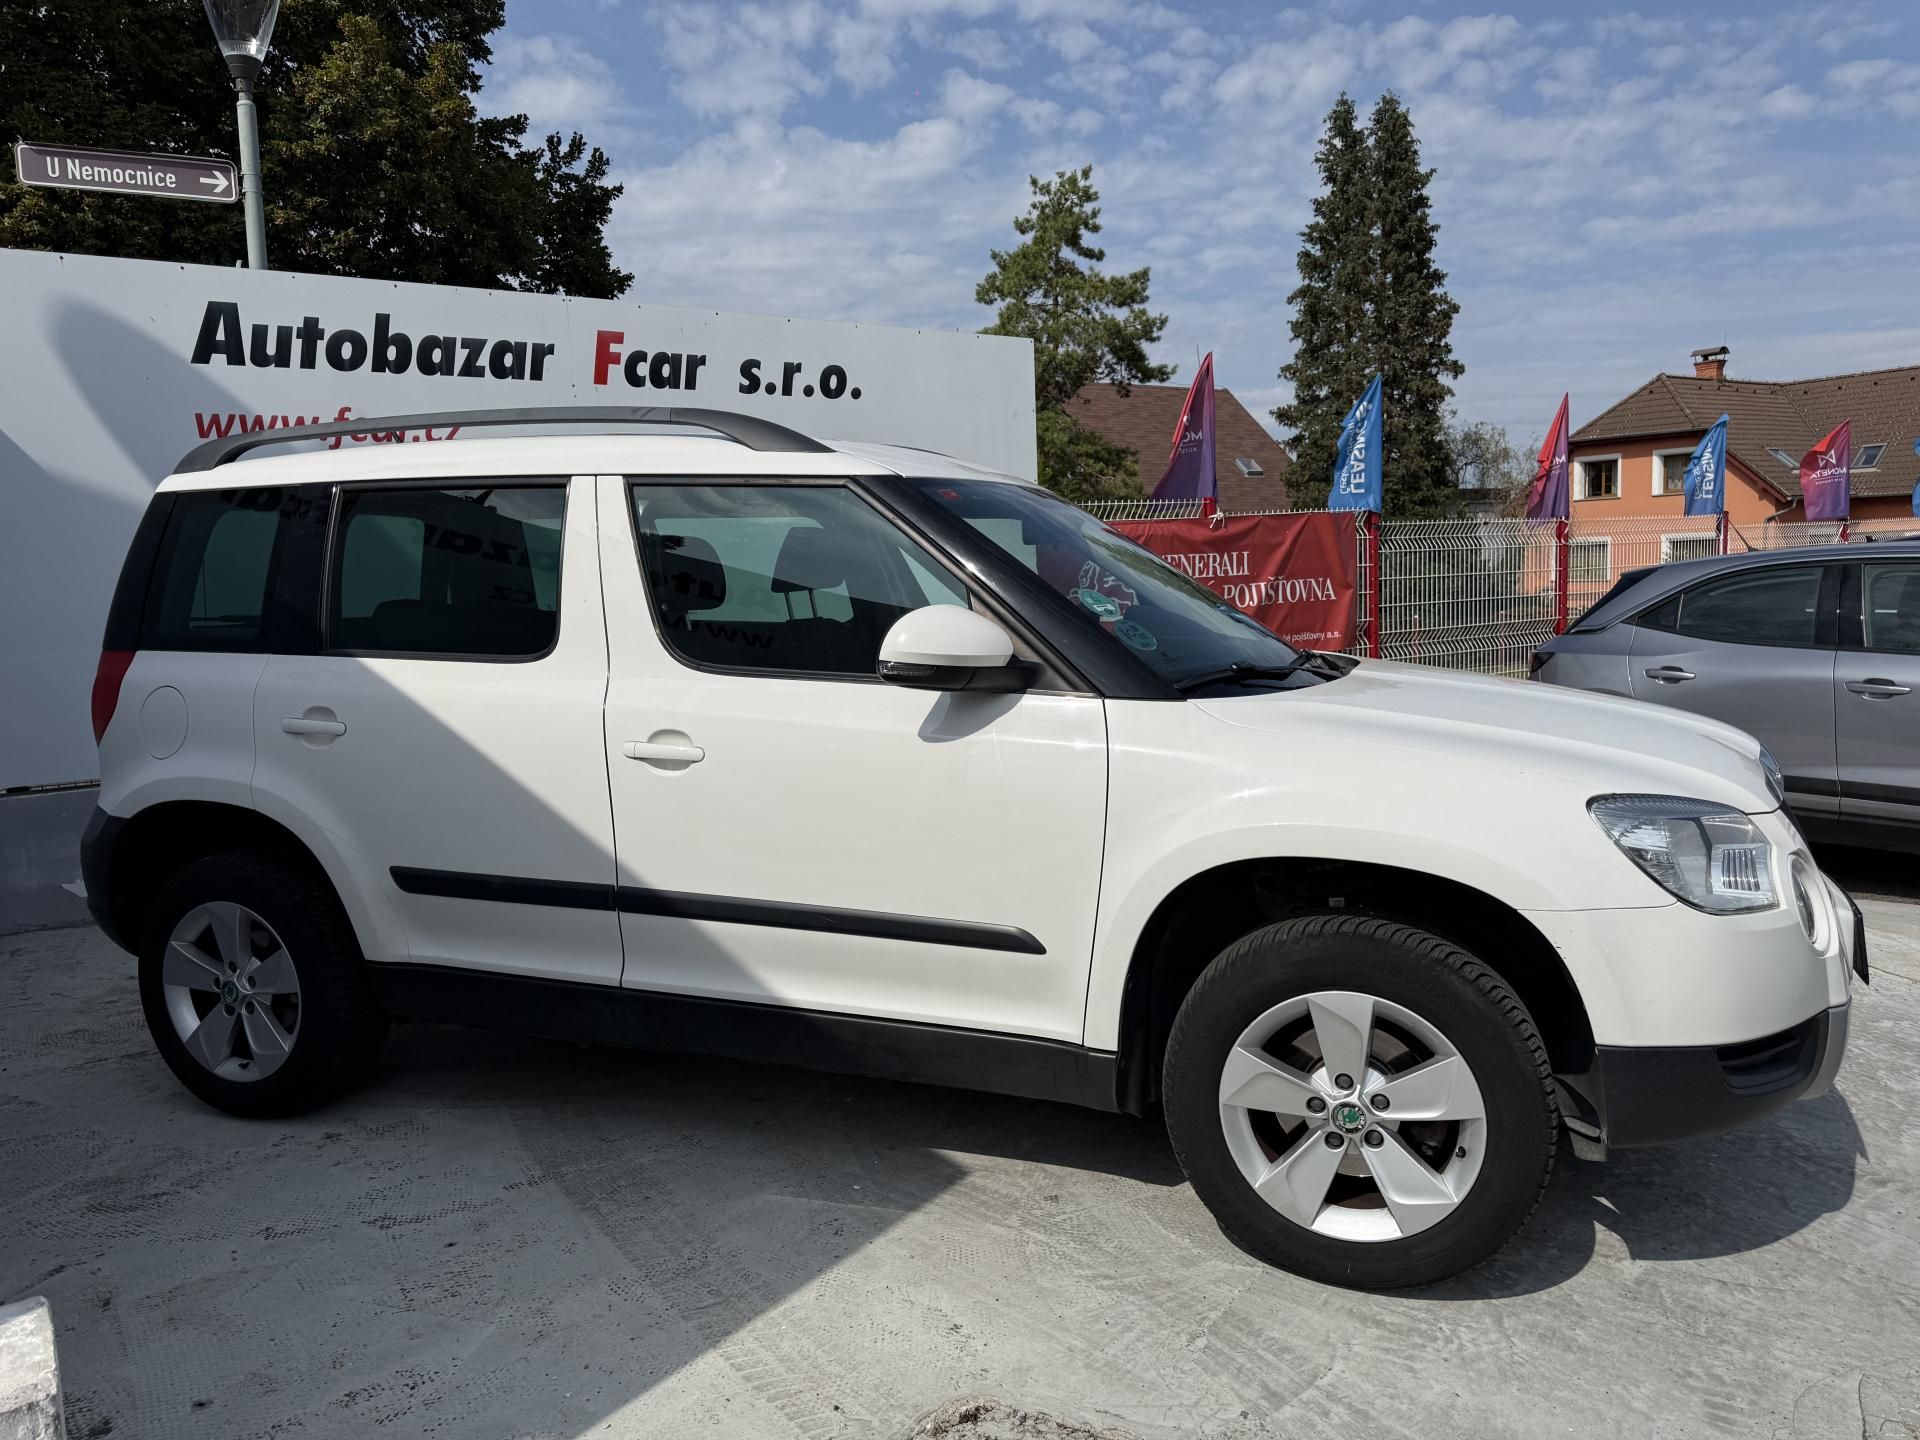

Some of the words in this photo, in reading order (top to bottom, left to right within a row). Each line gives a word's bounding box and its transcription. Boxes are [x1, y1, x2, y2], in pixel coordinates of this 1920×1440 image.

[46, 156, 60, 178] U
[66, 158, 176, 188] Nemocnice
[190, 300, 555, 381] Autobazar
[593, 329, 707, 390] Fcar
[739, 358, 862, 400] s.r.o.
[1161, 551, 1250, 578] ENERALI
[1223, 577, 1337, 608] POJIŠŤOVNA
[1326, 630, 1342, 639] a.s.
